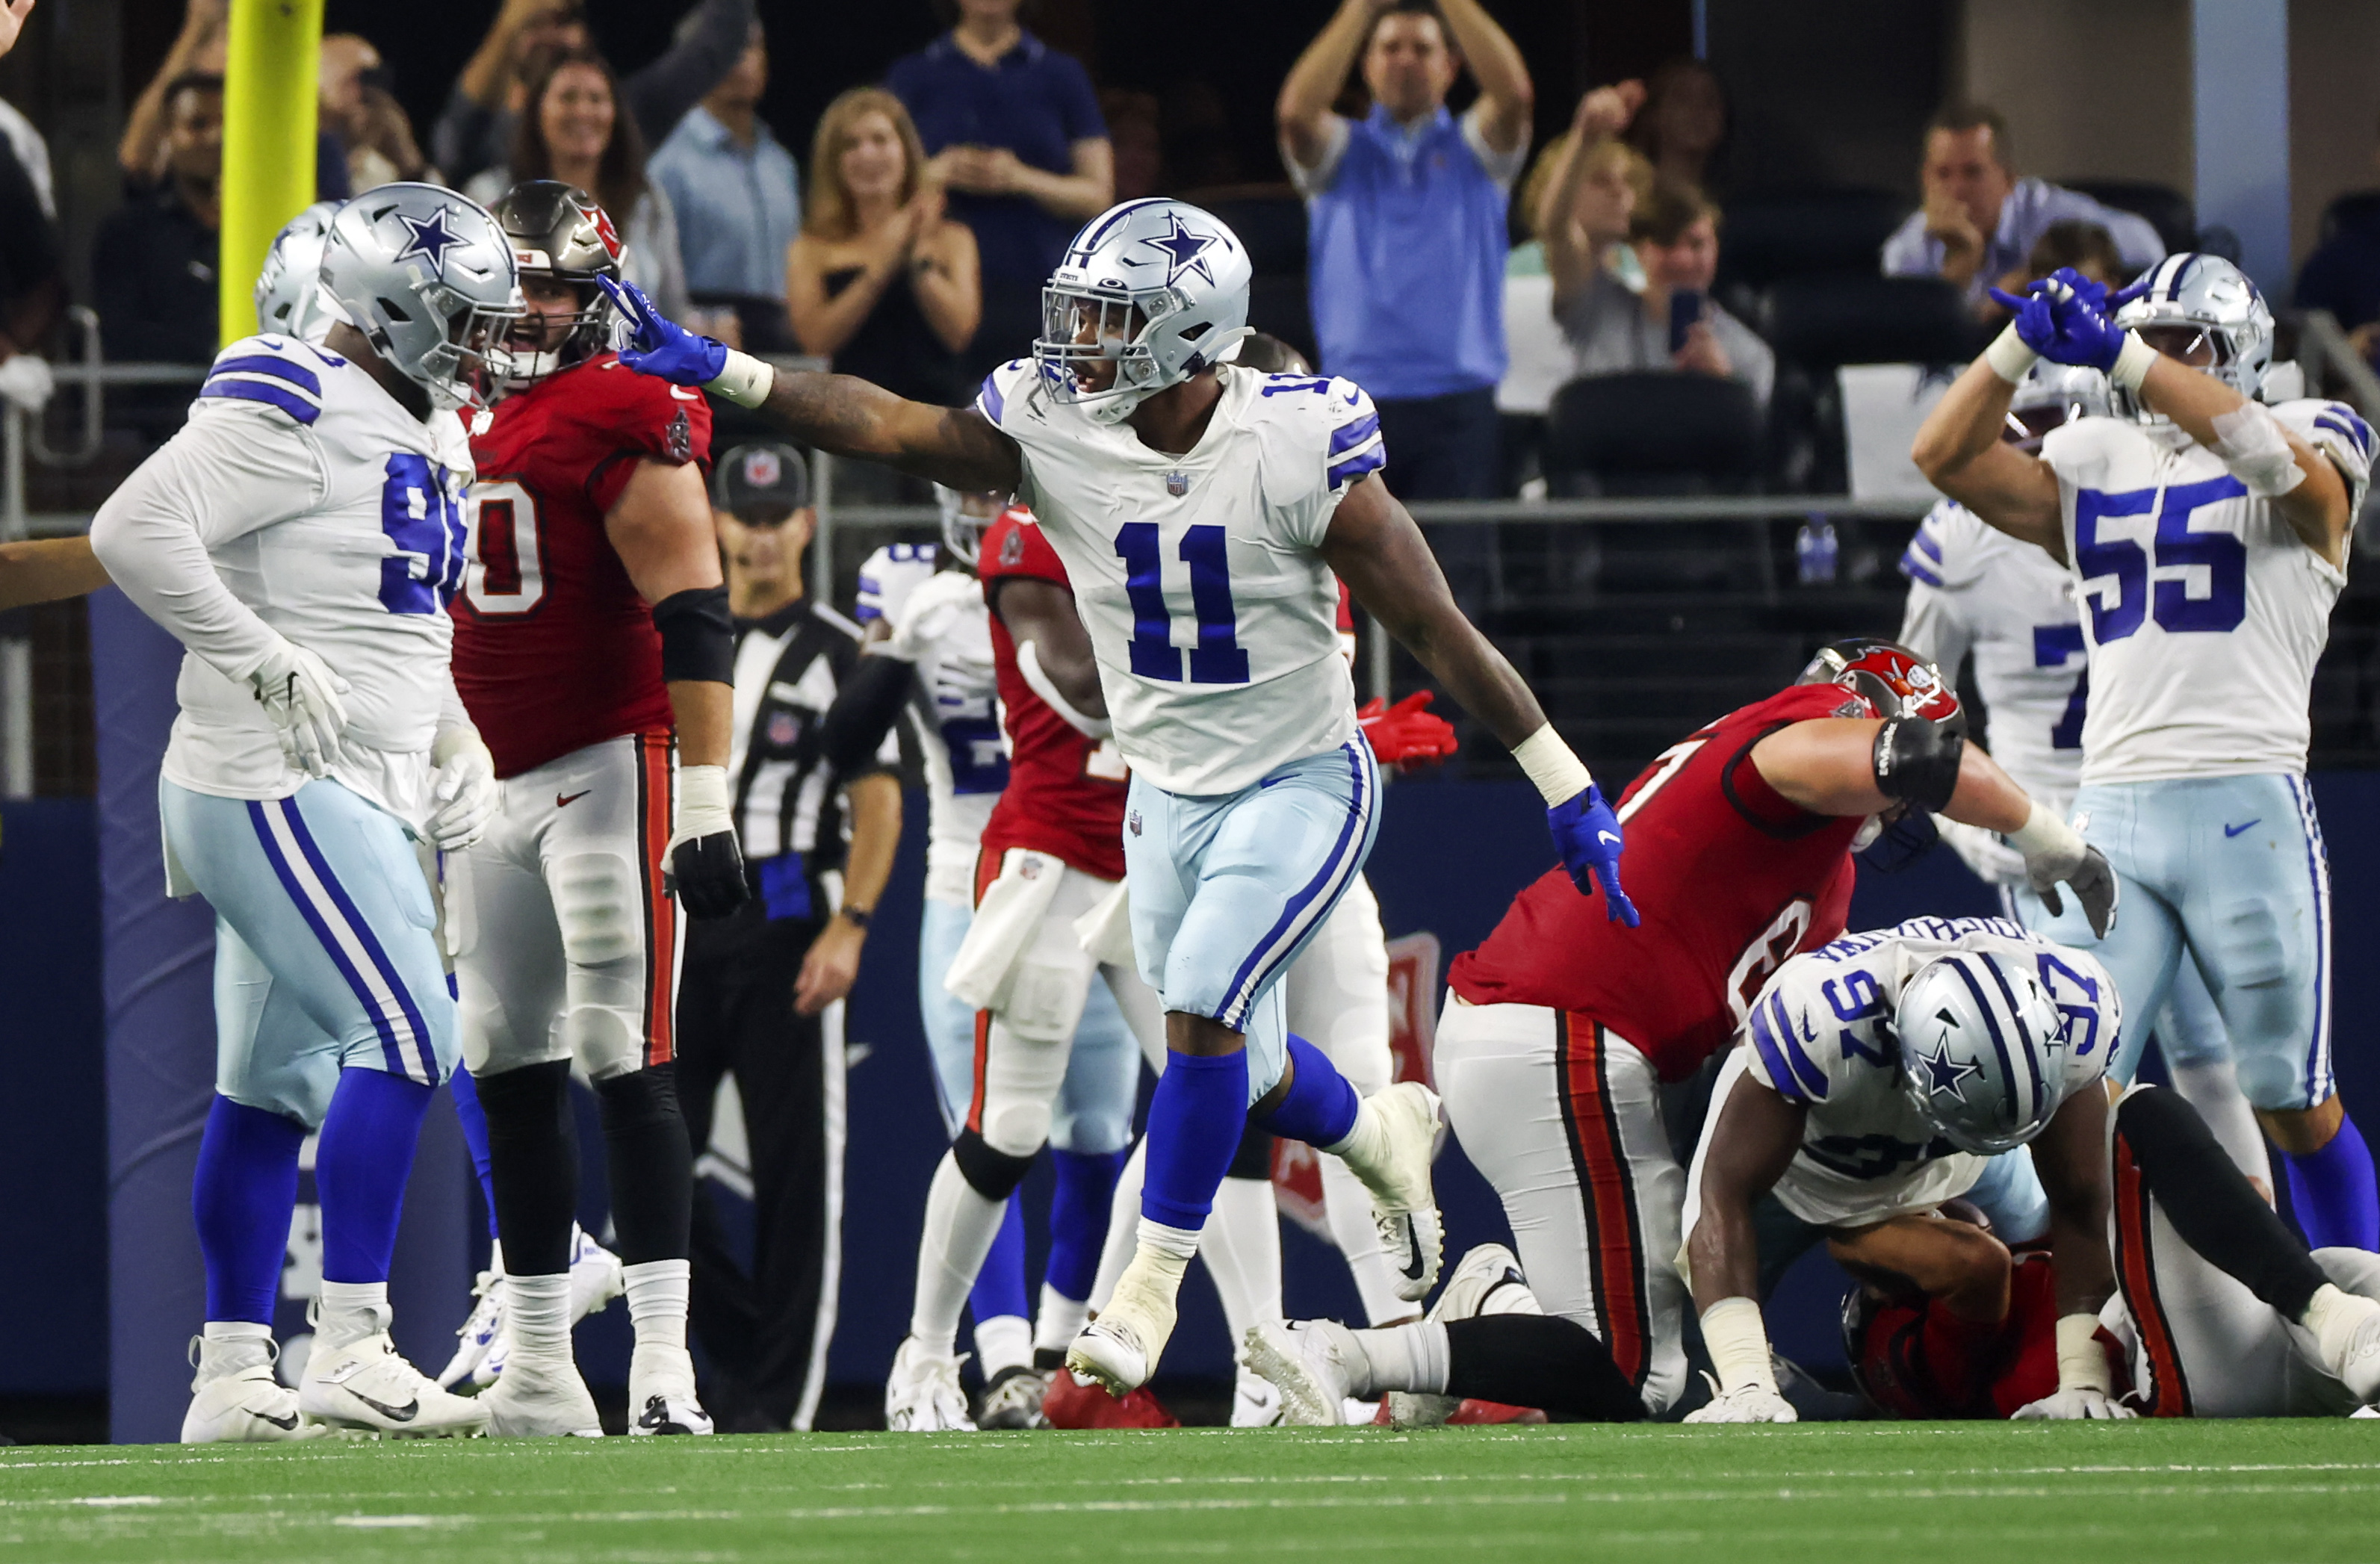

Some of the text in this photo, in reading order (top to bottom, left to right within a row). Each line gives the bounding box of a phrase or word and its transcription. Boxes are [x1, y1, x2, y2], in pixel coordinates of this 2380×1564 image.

[1115, 521, 1251, 684] 11
[2075, 474, 2248, 647] 55
[1821, 968, 1901, 1068] 97
[2036, 952, 2099, 1056] 97
